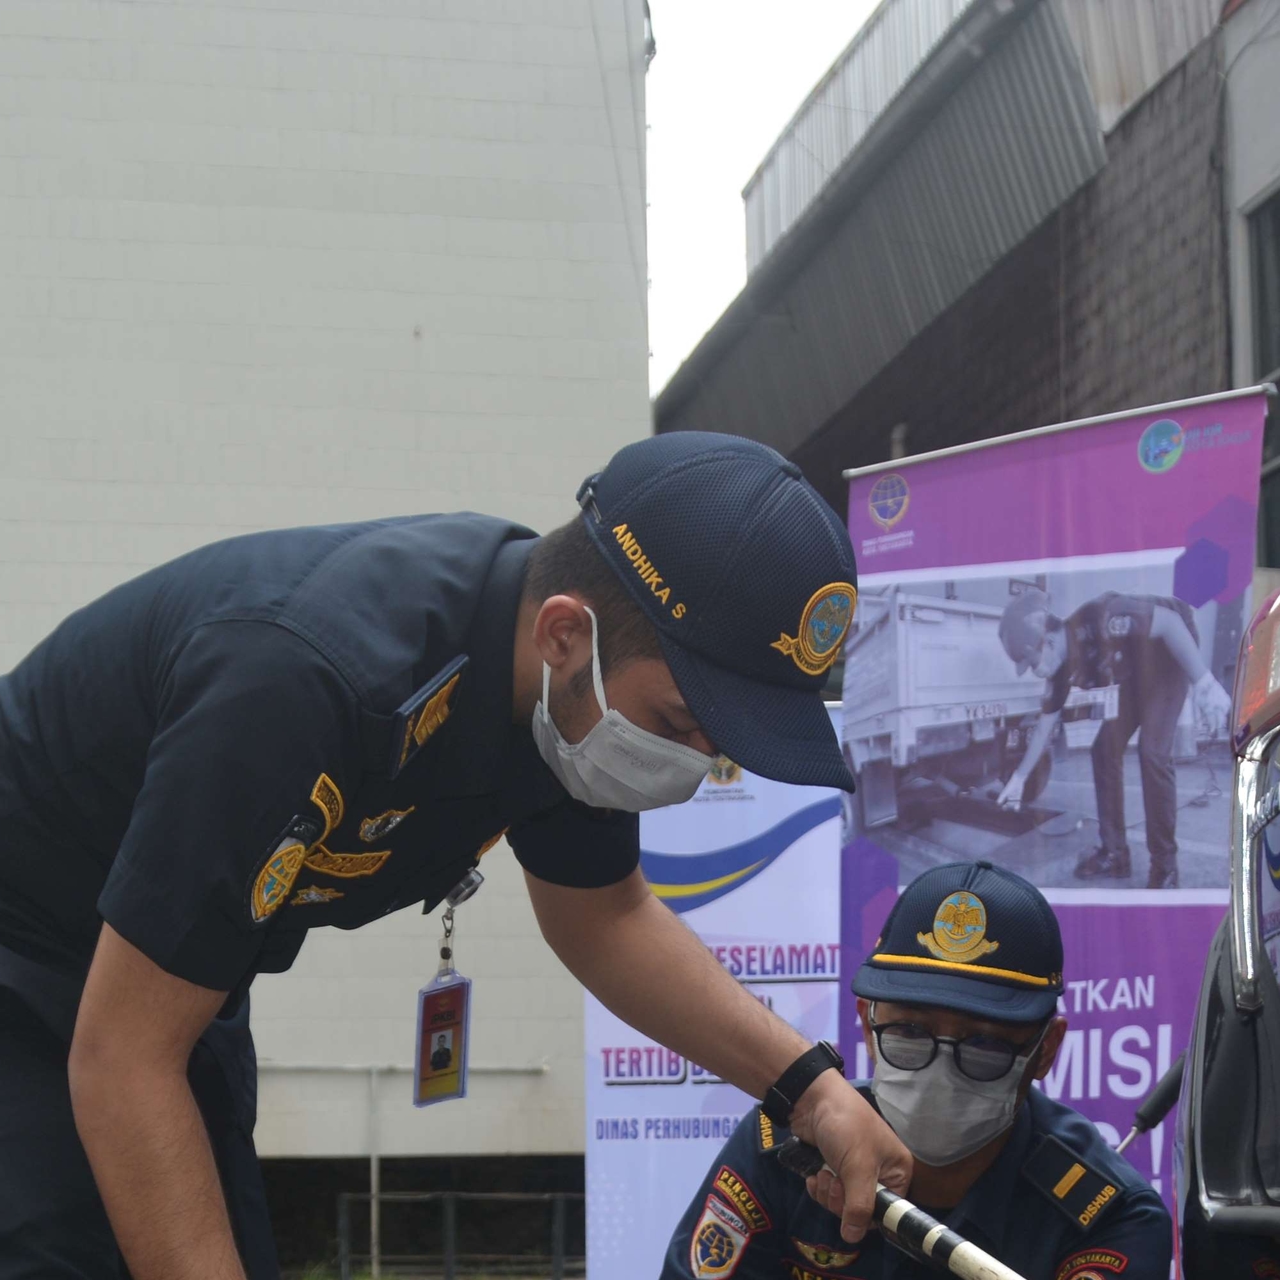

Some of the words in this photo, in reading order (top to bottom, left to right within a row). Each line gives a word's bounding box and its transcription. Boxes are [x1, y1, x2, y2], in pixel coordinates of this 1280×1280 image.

[612, 523, 671, 604] ANDHIKA
[671, 603, 687, 618] S
[710, 943, 840, 976] ESELAMAT
[601, 1046, 682, 1079] TERTIB
[1038, 1024, 1172, 1100] MISI
[596, 1118, 638, 1140] DINAS
[758, 1109, 775, 1149] ISHUB
[720, 1170, 767, 1227] PENGUJI
[1078, 1184, 1117, 1227] DISHUB
